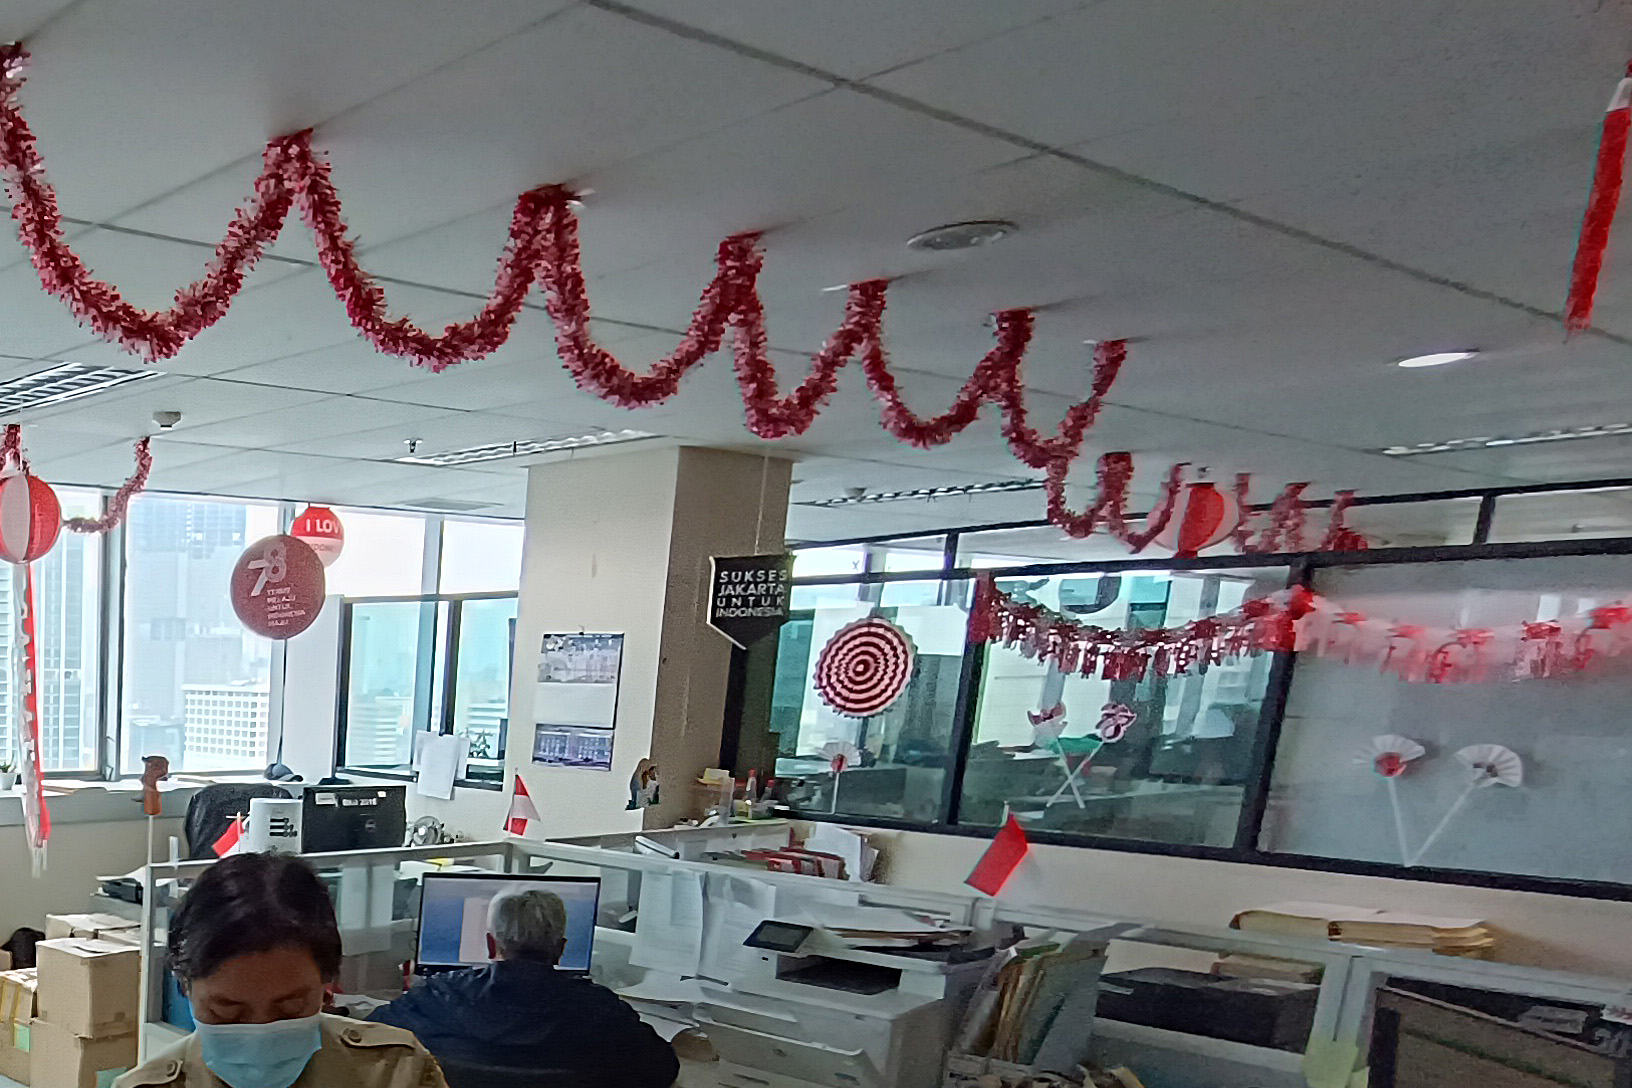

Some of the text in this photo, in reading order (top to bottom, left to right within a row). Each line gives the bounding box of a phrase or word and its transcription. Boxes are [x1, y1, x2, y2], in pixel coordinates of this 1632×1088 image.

[305, 518, 311, 533] I
[719, 569, 787, 583] SUKSES
[718, 583, 787, 596] JAKARTA
[716, 596, 785, 607] UNTUK
[715, 606, 783, 618] INDONESIA
